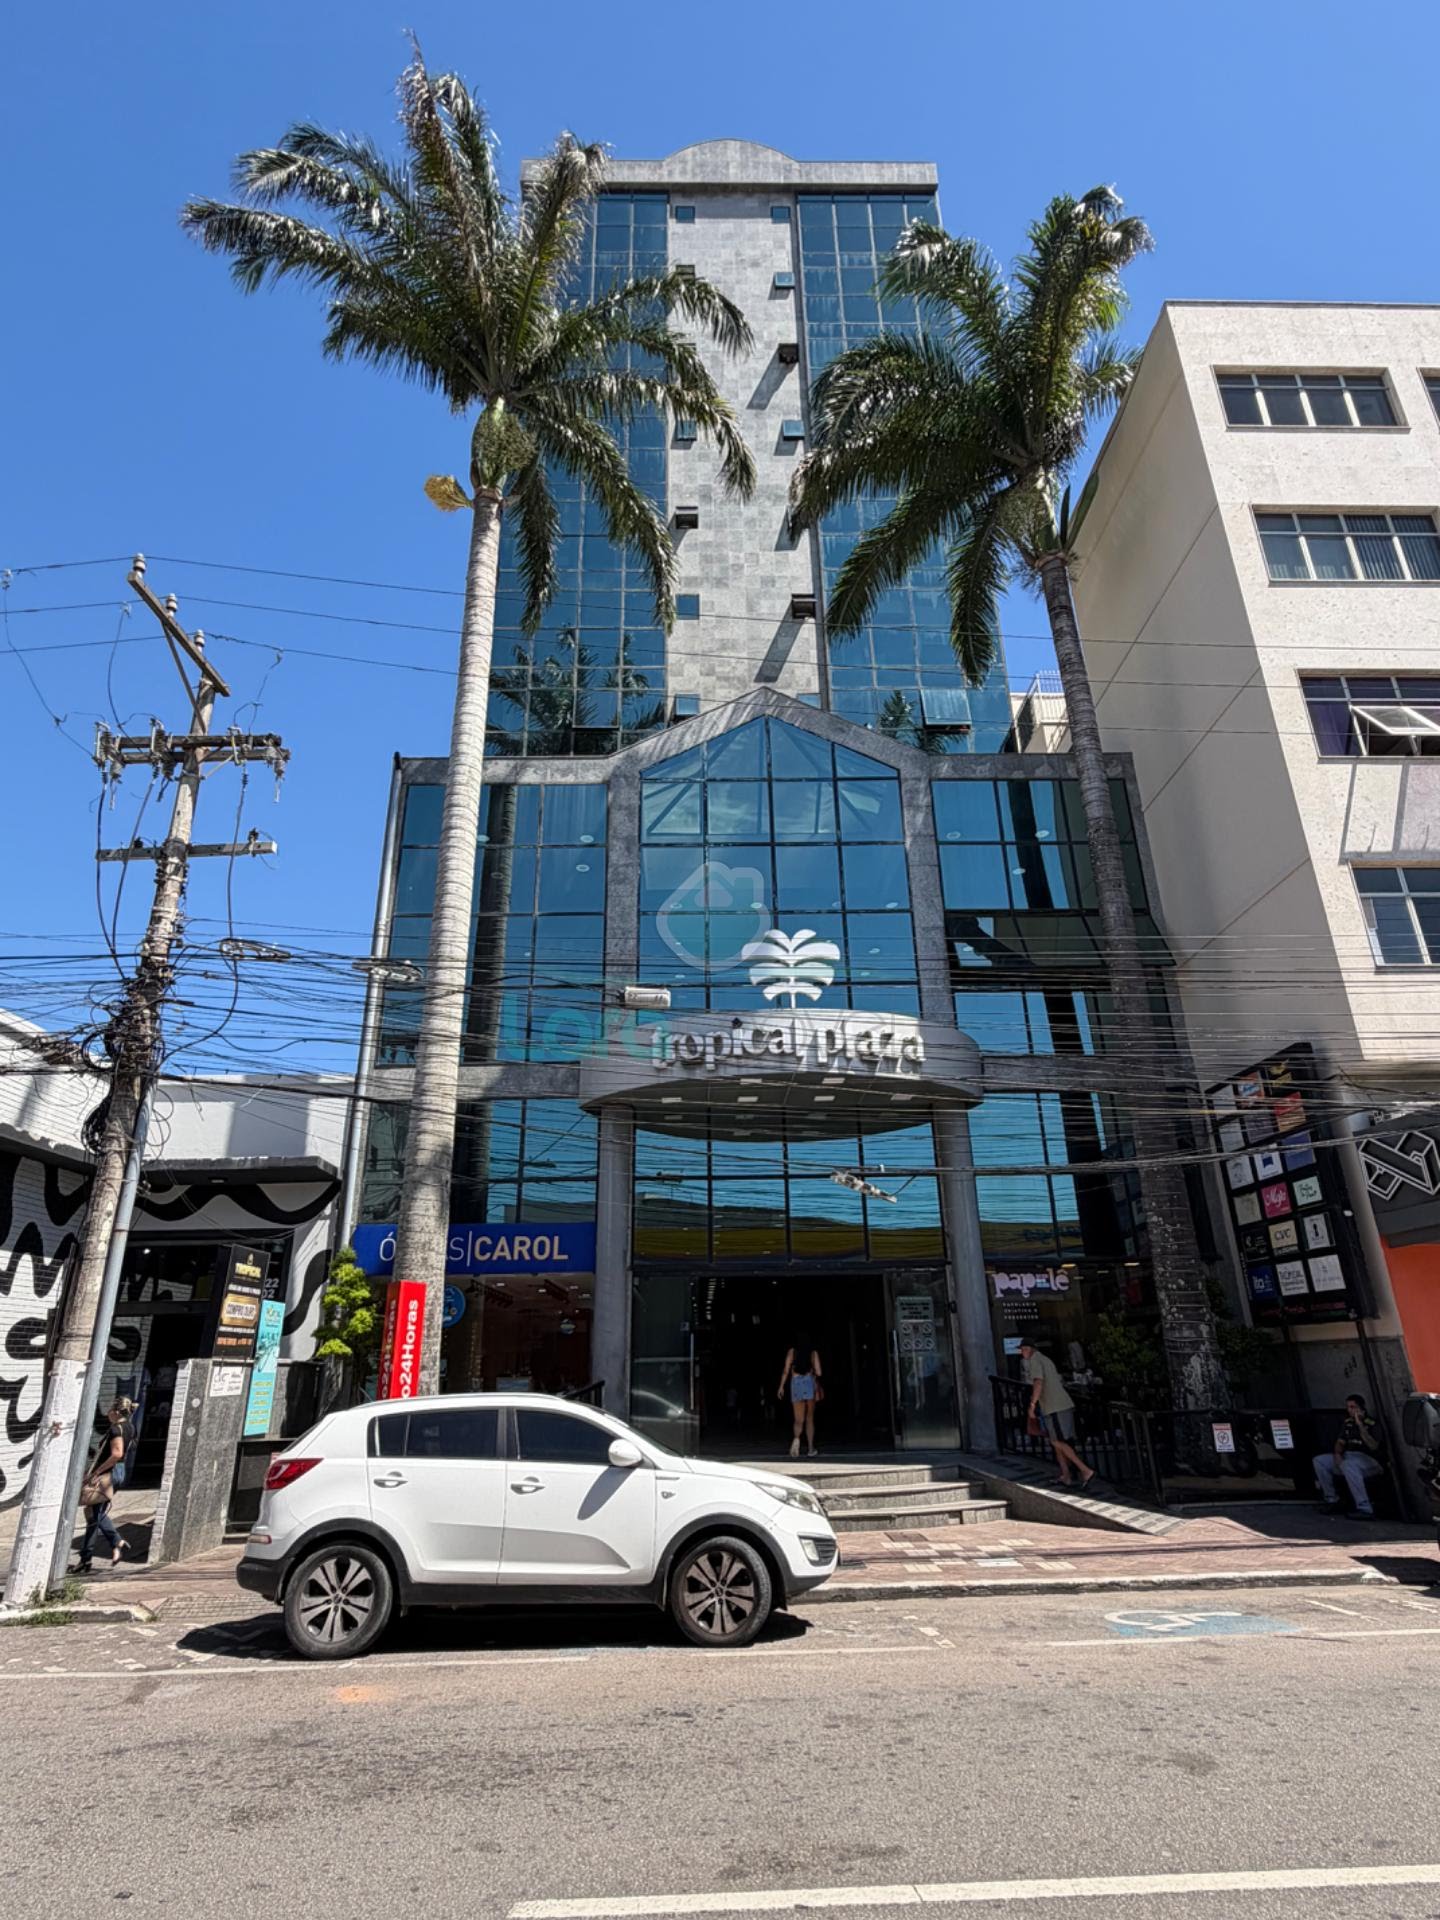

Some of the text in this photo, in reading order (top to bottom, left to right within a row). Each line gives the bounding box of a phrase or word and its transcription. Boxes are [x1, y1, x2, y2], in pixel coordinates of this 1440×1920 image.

[651, 1017, 927, 1070] tropical plaza
[474, 1235, 569, 1261] CAROL
[400, 1299, 419, 1399] o24Horas
